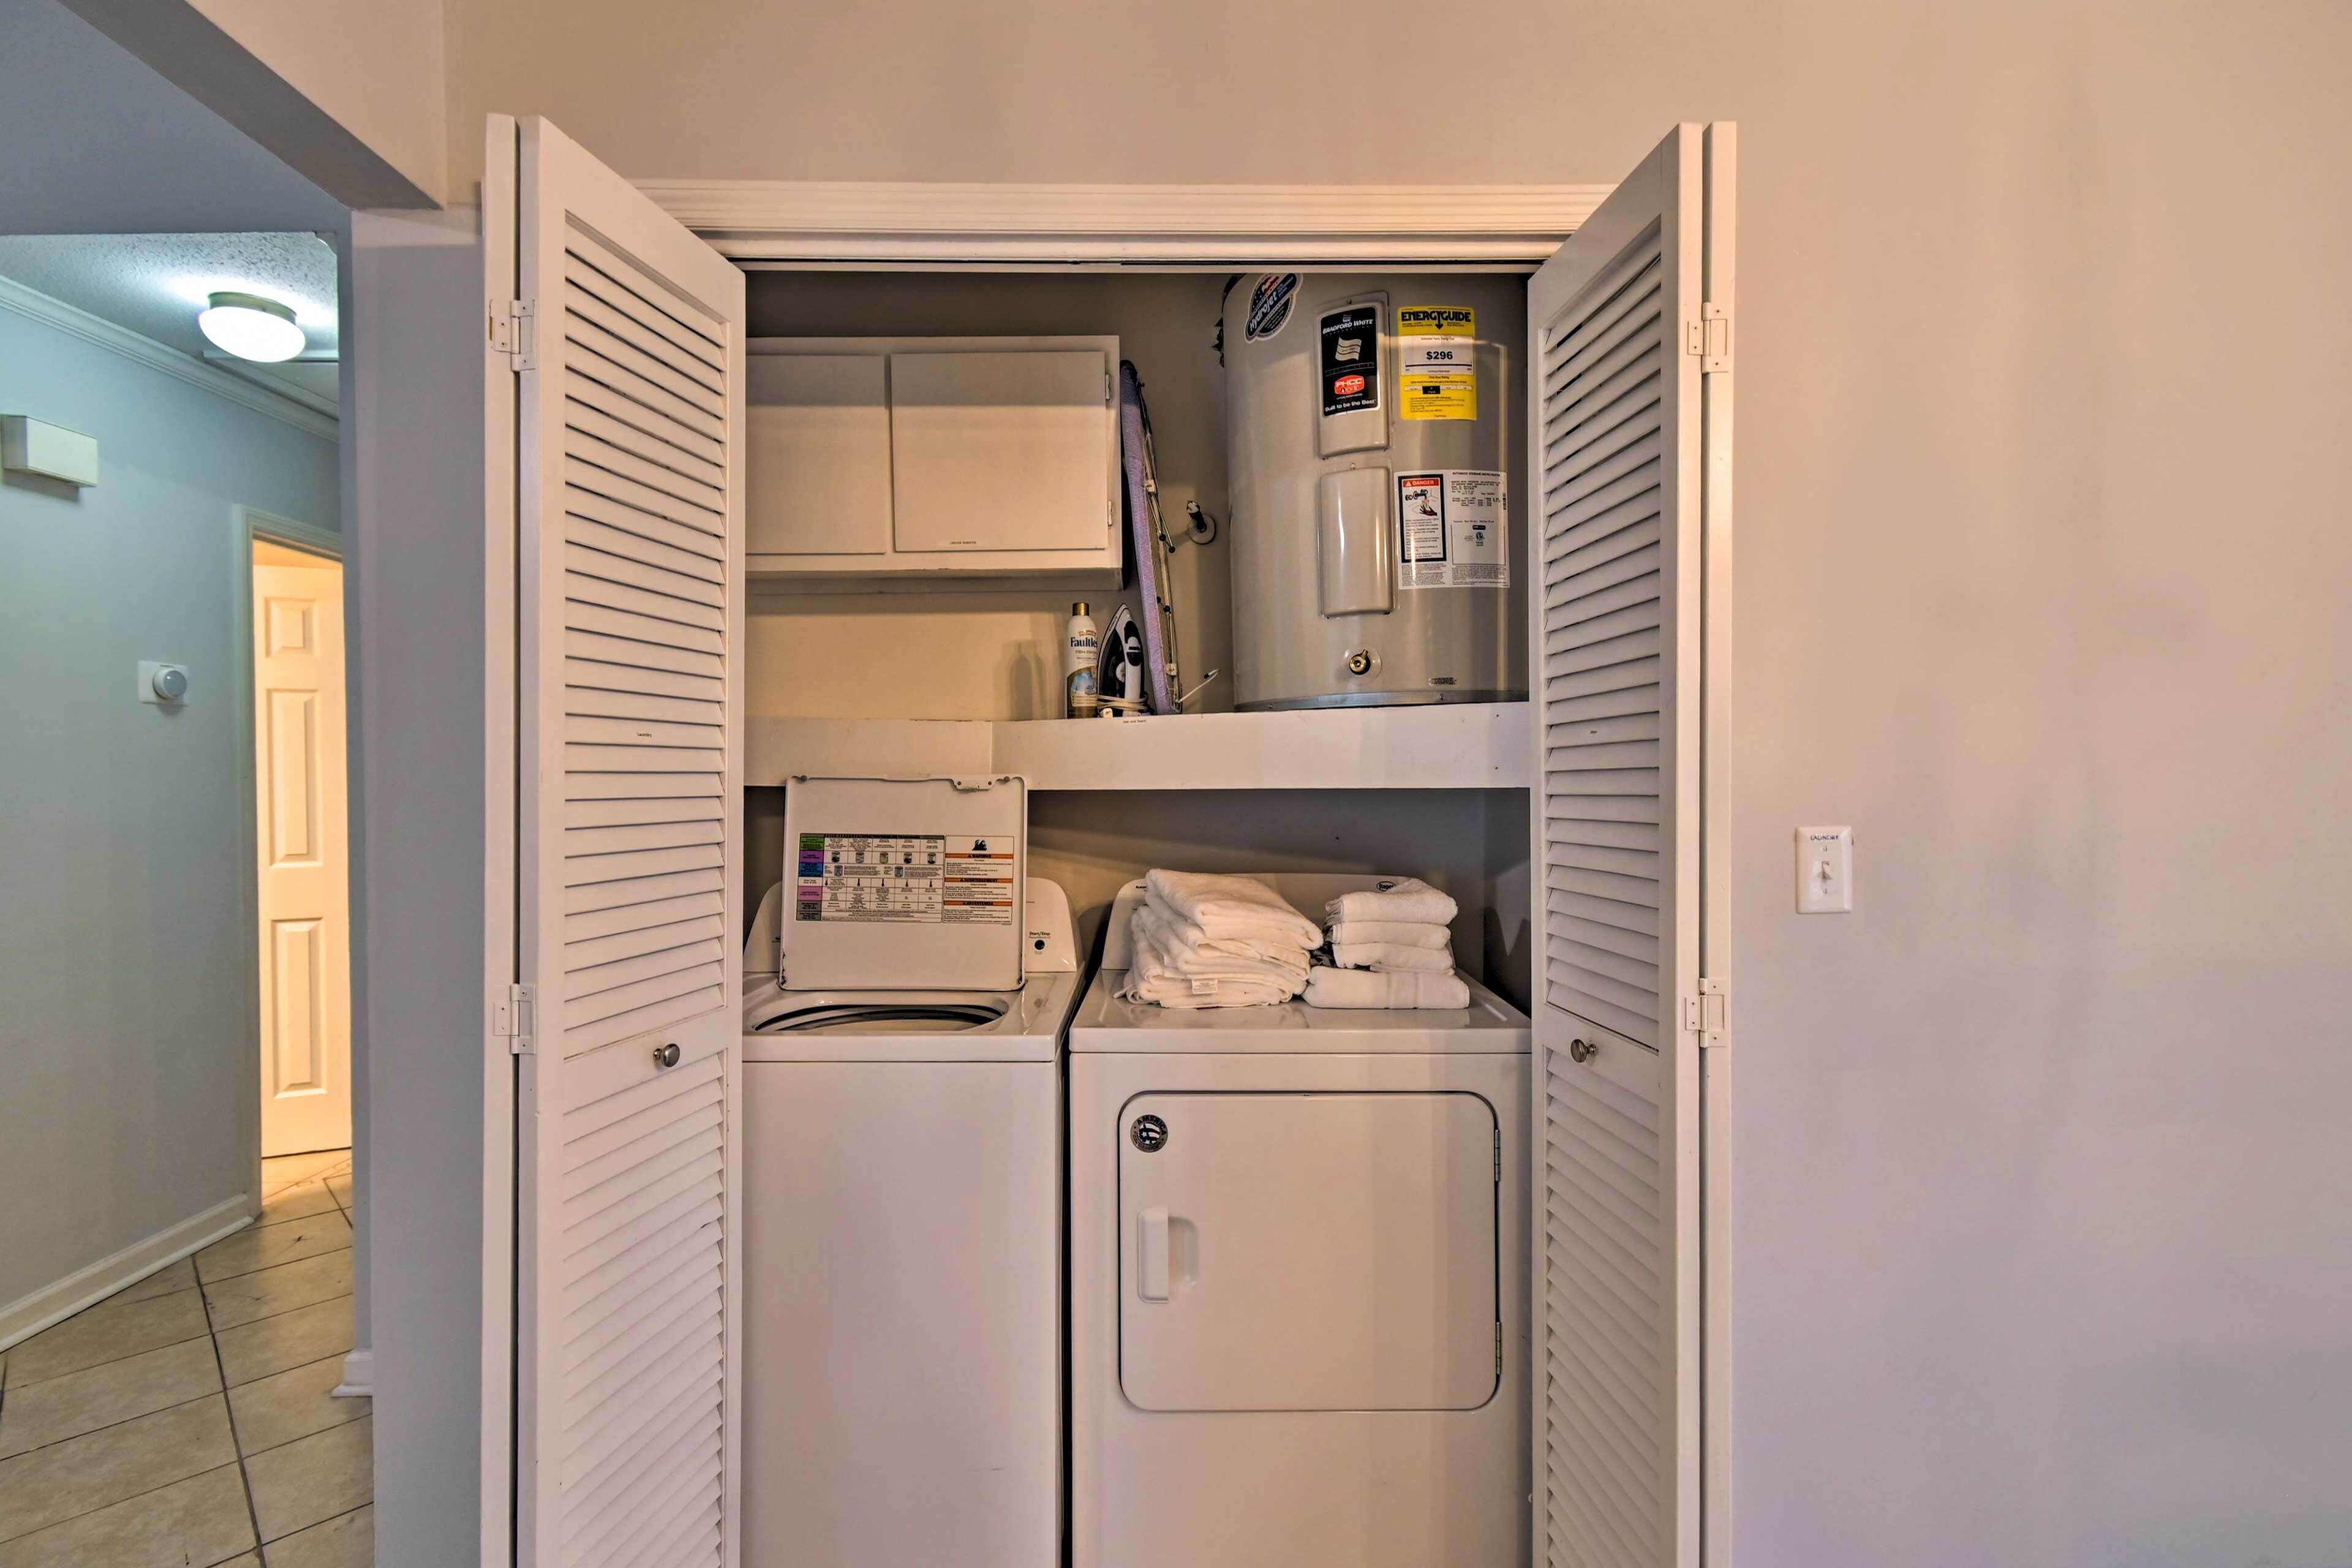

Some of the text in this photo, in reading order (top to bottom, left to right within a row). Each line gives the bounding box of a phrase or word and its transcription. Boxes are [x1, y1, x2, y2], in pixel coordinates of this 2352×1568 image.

[1250, 291, 1278, 332] Hydrojet
[1401, 311, 1471, 322] ENERGYGUIDE
[1323, 322, 1352, 334] BRADFORD
[1426, 351, 1453, 360] $296
[1336, 378, 1363, 388] PHCC
[1136, 1115, 1167, 1136] AMERICA
